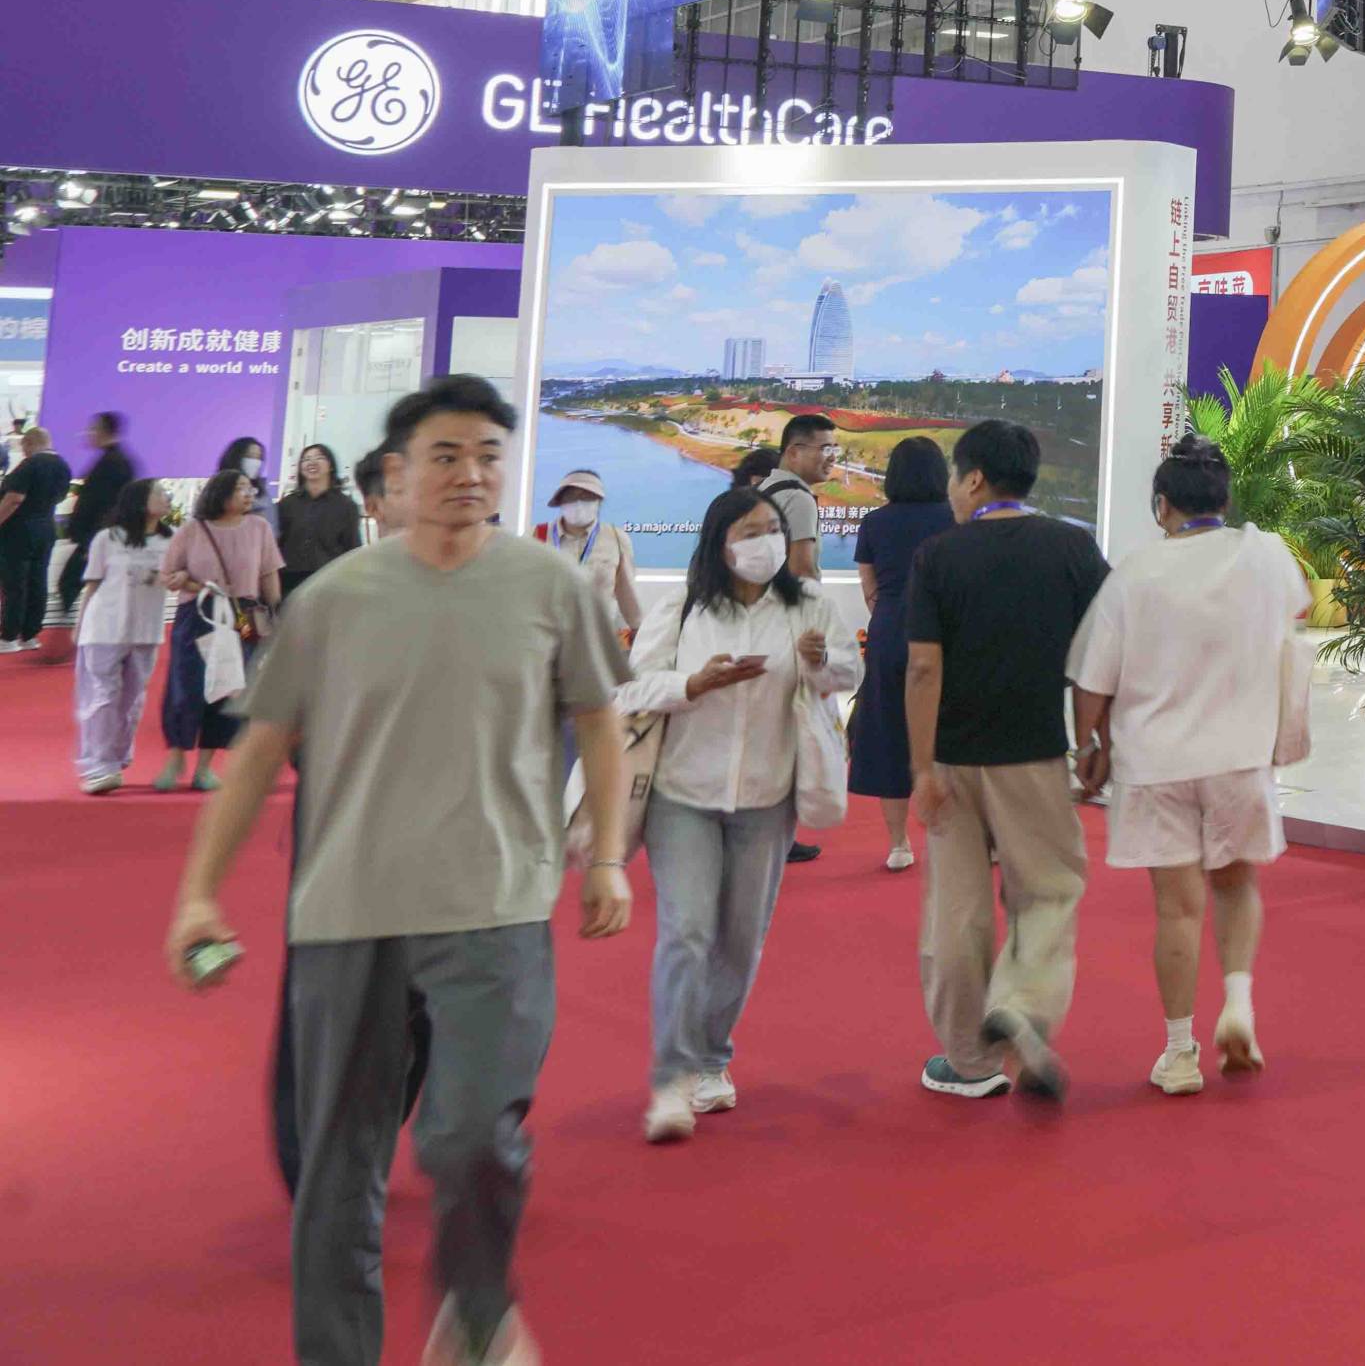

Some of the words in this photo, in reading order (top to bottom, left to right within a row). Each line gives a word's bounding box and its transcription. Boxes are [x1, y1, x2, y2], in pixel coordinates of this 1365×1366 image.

[117, 359, 173, 374] Create
[178, 362, 190, 374] a
[195, 361, 243, 374] world
[624, 520, 635, 532] is
[643, 521, 673, 535] major
